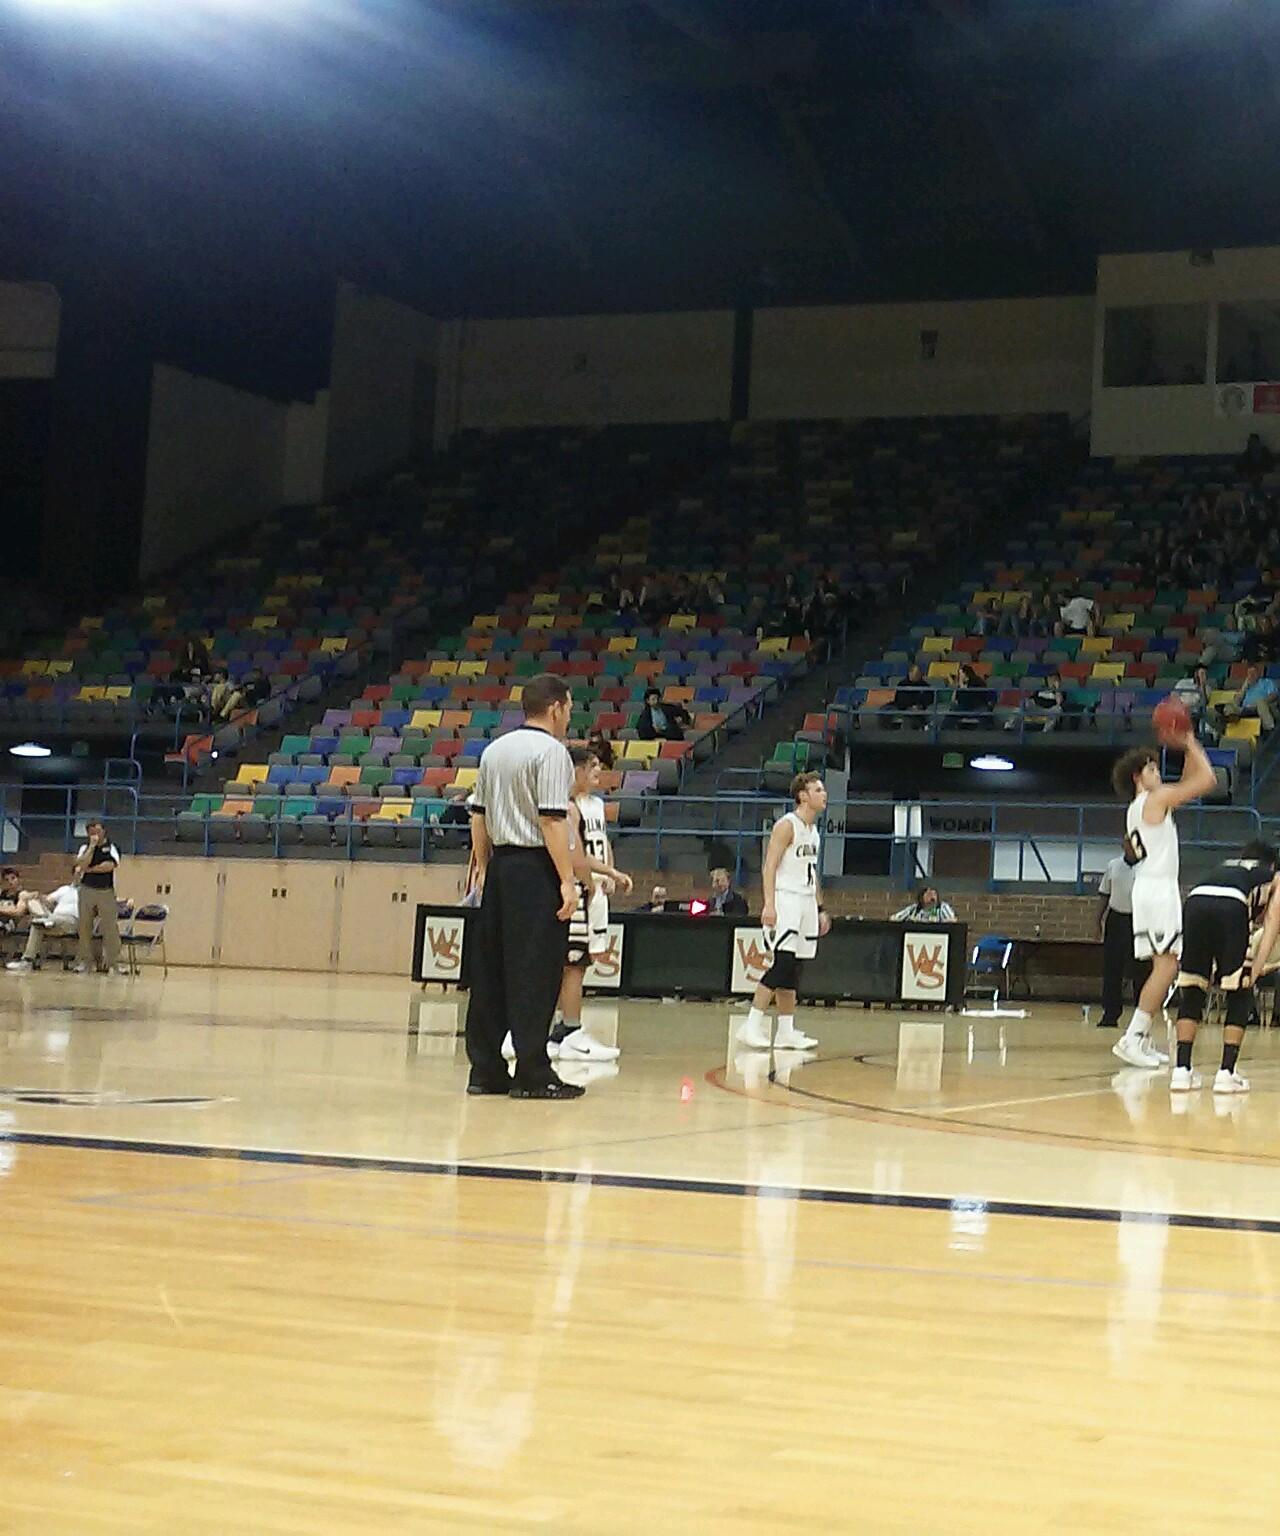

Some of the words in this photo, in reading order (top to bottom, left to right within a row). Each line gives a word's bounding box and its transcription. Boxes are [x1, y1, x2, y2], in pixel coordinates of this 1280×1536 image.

[929, 815, 992, 833] WOMEN
[427, 926, 461, 970] WS
[906, 943, 944, 990] WS
